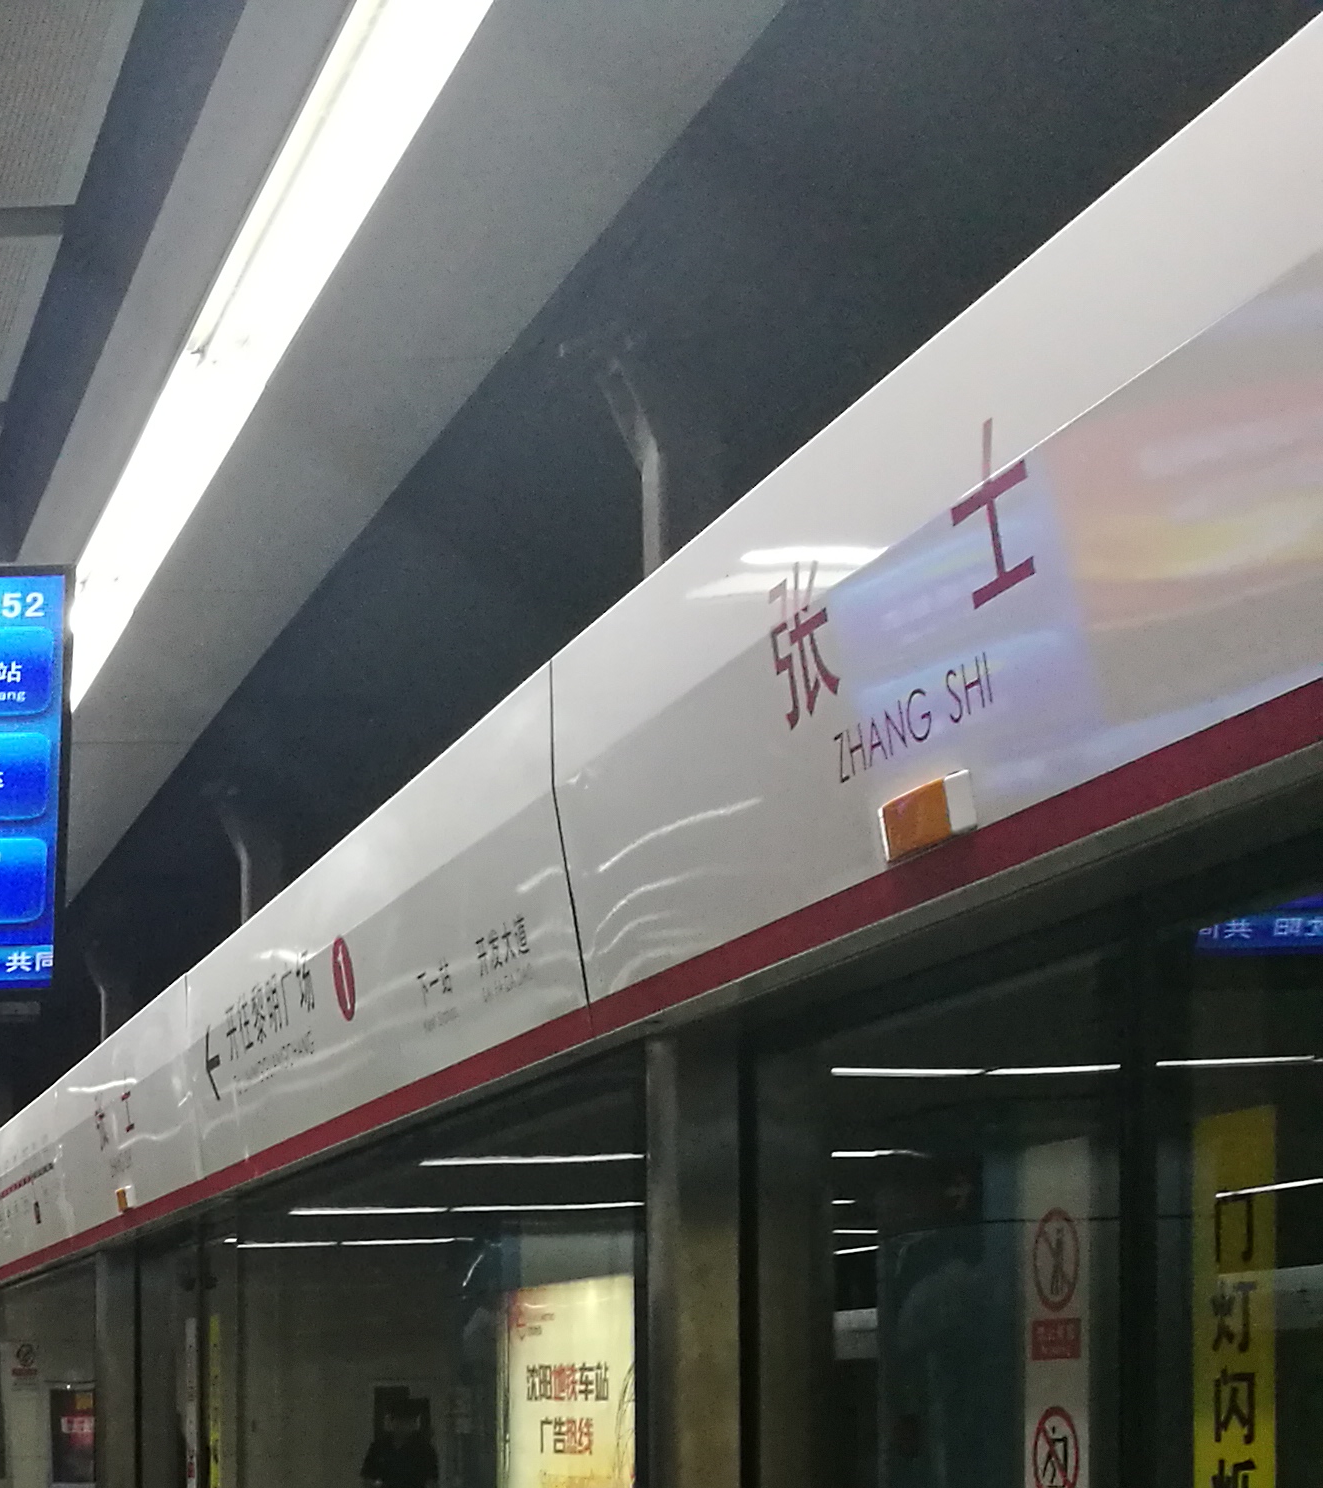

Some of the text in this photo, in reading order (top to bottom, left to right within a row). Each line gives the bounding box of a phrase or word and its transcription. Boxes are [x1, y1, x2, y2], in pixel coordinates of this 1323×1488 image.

[832, 651, 995, 785] ZHANG SHI
[525, 1362, 610, 1403] 沈阳地铁车站
[539, 1416, 595, 1456] 广告热线
